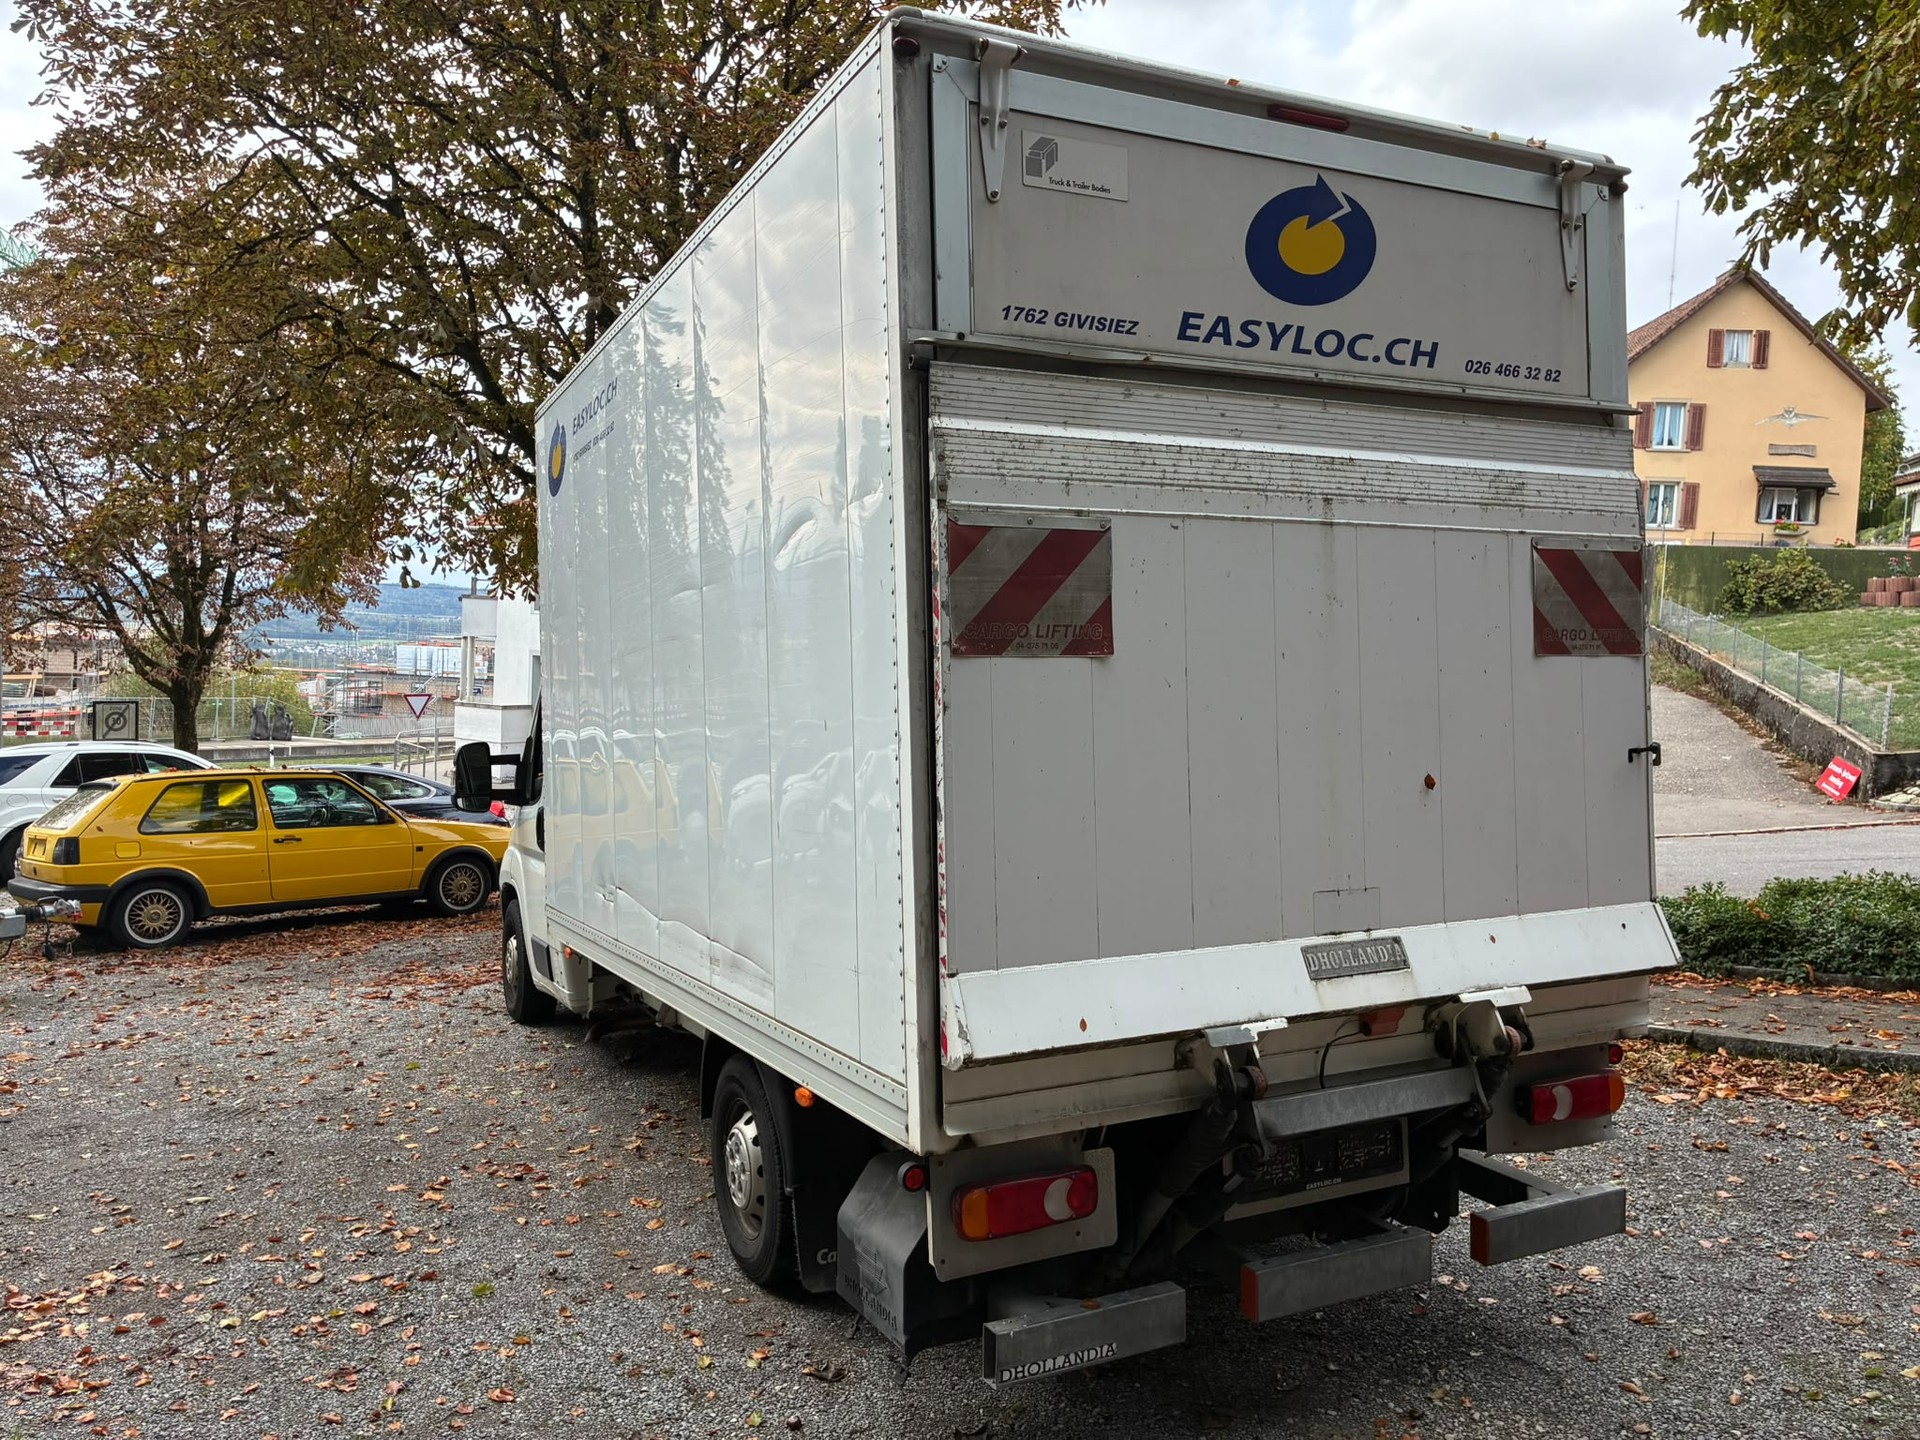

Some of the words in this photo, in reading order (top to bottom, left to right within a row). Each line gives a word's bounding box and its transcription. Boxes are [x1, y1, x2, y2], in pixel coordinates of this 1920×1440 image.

[1049, 177, 1065, 187] Truck
[1072, 181, 1090, 190] Trailer
[1091, 184, 1111, 194] Bodies
[1002, 305, 1049, 325] 1762
[1054, 311, 1139, 335] GIVISIEZ
[1177, 311, 1439, 369] EASYLOC.CH
[1465, 360, 1491, 375] 026
[1495, 363, 1520, 378] 466
[1524, 366, 1541, 381] 32
[1544, 369, 1561, 382] 82
[964, 622, 1029, 640] CARGO
[1035, 623, 1104, 640] LIFTING
[1306, 943, 1405, 971] DHOLLANDIA
[1306, 1177, 1342, 1190] EASYLOC.CH
[1001, 1342, 1117, 1383] DHOLLANDIA
